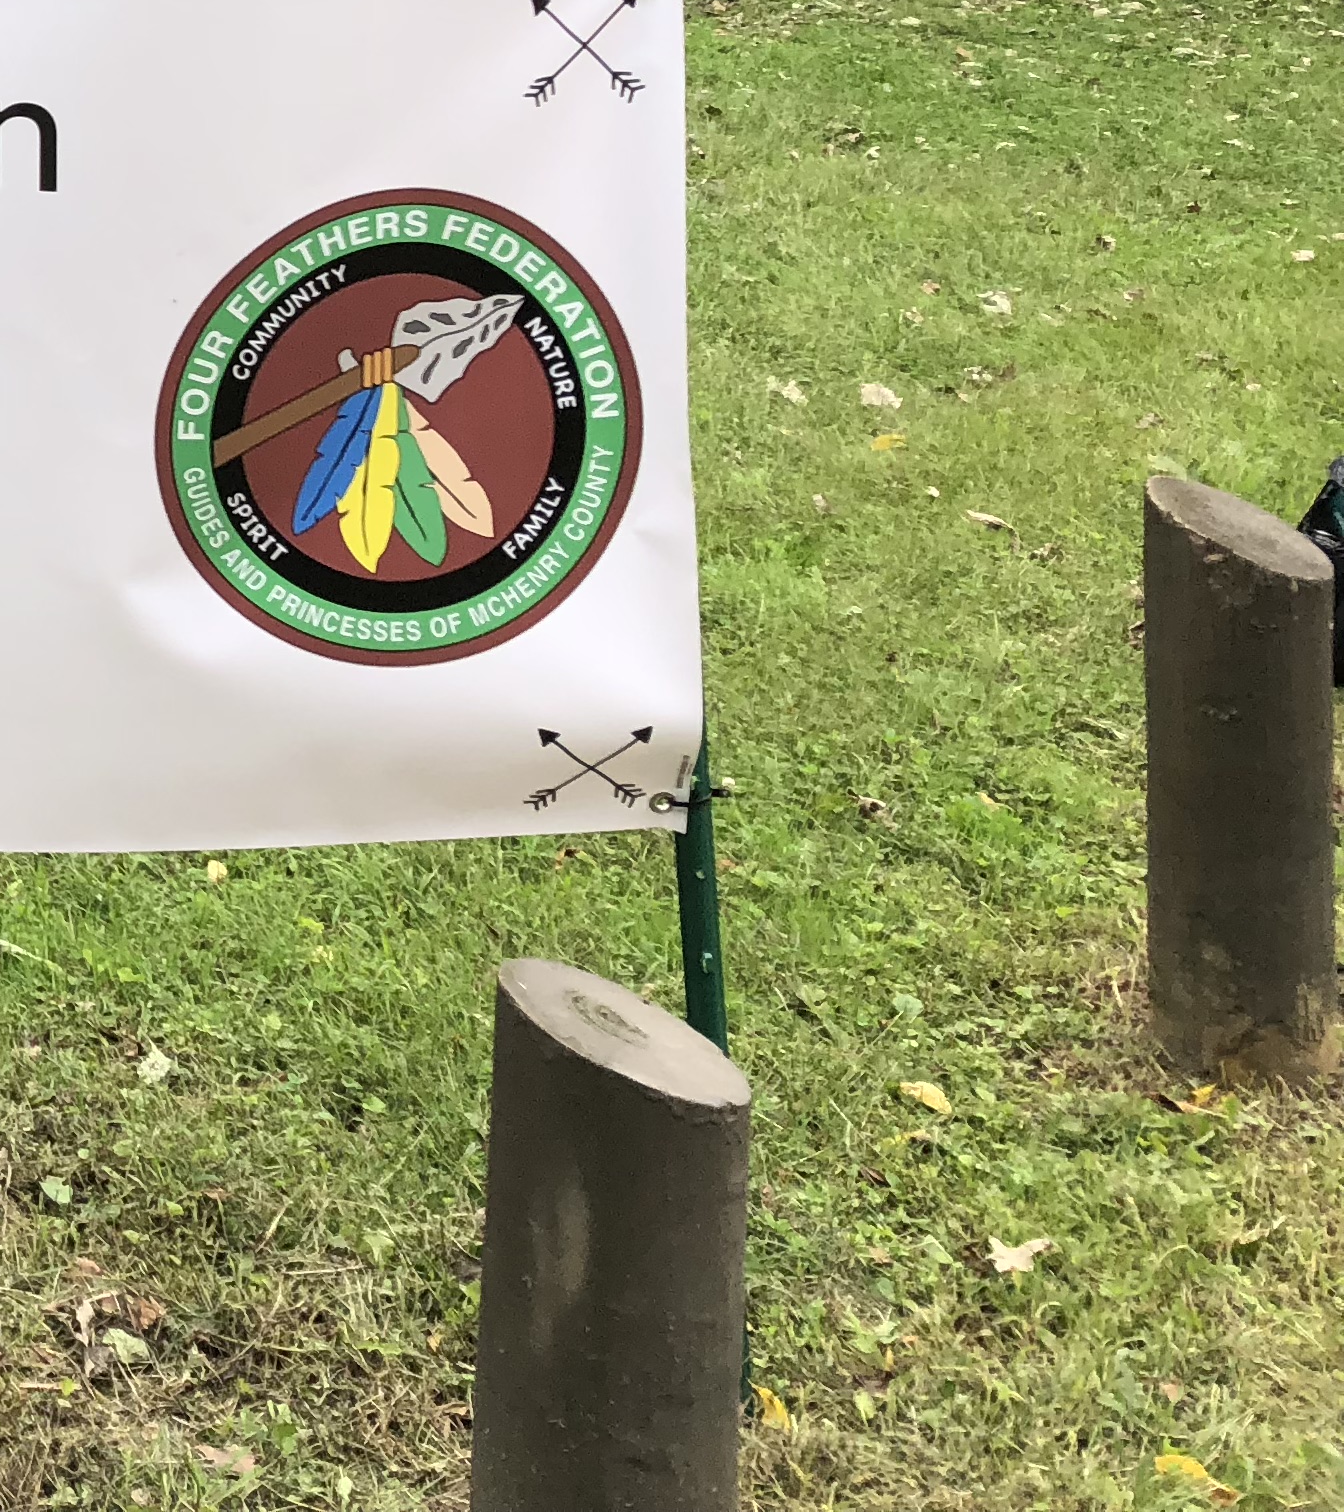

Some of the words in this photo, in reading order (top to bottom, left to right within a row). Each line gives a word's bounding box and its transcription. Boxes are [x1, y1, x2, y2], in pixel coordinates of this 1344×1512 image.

[176, 327, 234, 443] FOUR
[226, 209, 430, 325] FEATHERS
[441, 213, 620, 420] FEDERATION
[232, 264, 349, 382] COMMUNITY
[522, 316, 578, 410] NATURE
[182, 466, 229, 550] GUIDES
[221, 547, 269, 593] AND
[265, 584, 423, 644] PRINCESSES
[429, 617, 463, 640] OF
[467, 544, 572, 636] MCHENRY
[563, 444, 615, 542] COUNTY
[226, 491, 290, 563] SPIRIT
[501, 476, 566, 561] FAMILY
